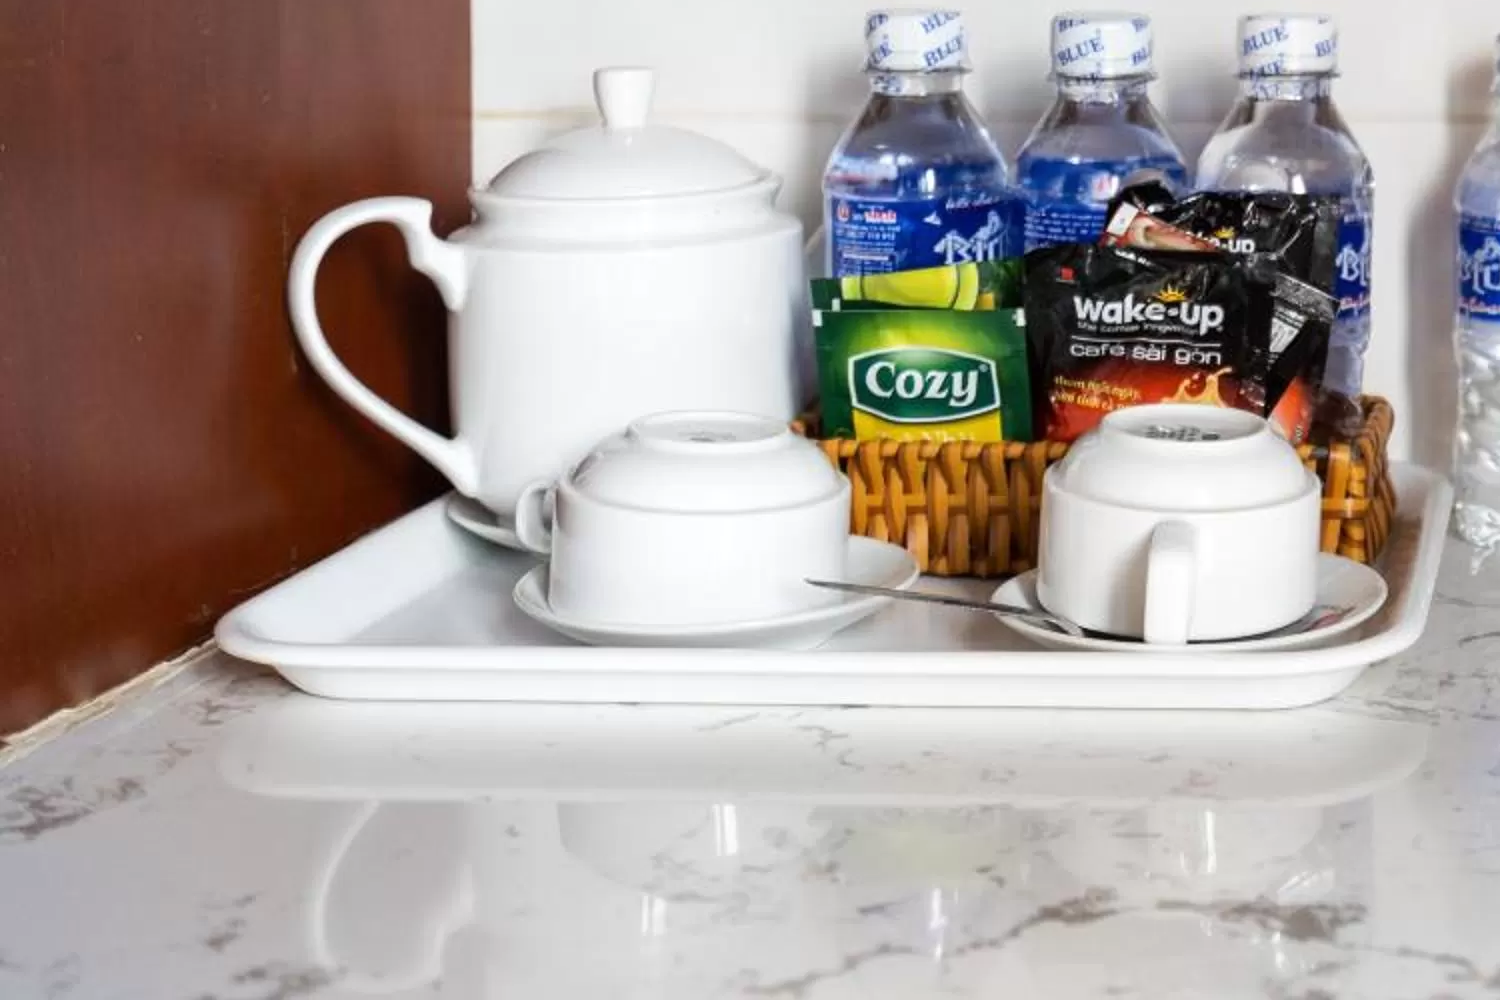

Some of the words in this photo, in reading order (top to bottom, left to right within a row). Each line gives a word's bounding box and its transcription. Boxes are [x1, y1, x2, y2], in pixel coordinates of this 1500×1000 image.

[1057, 36, 1104, 67] BLUE
[1242, 24, 1289, 57] BLUE
[865, 361, 979, 407] Cozy
